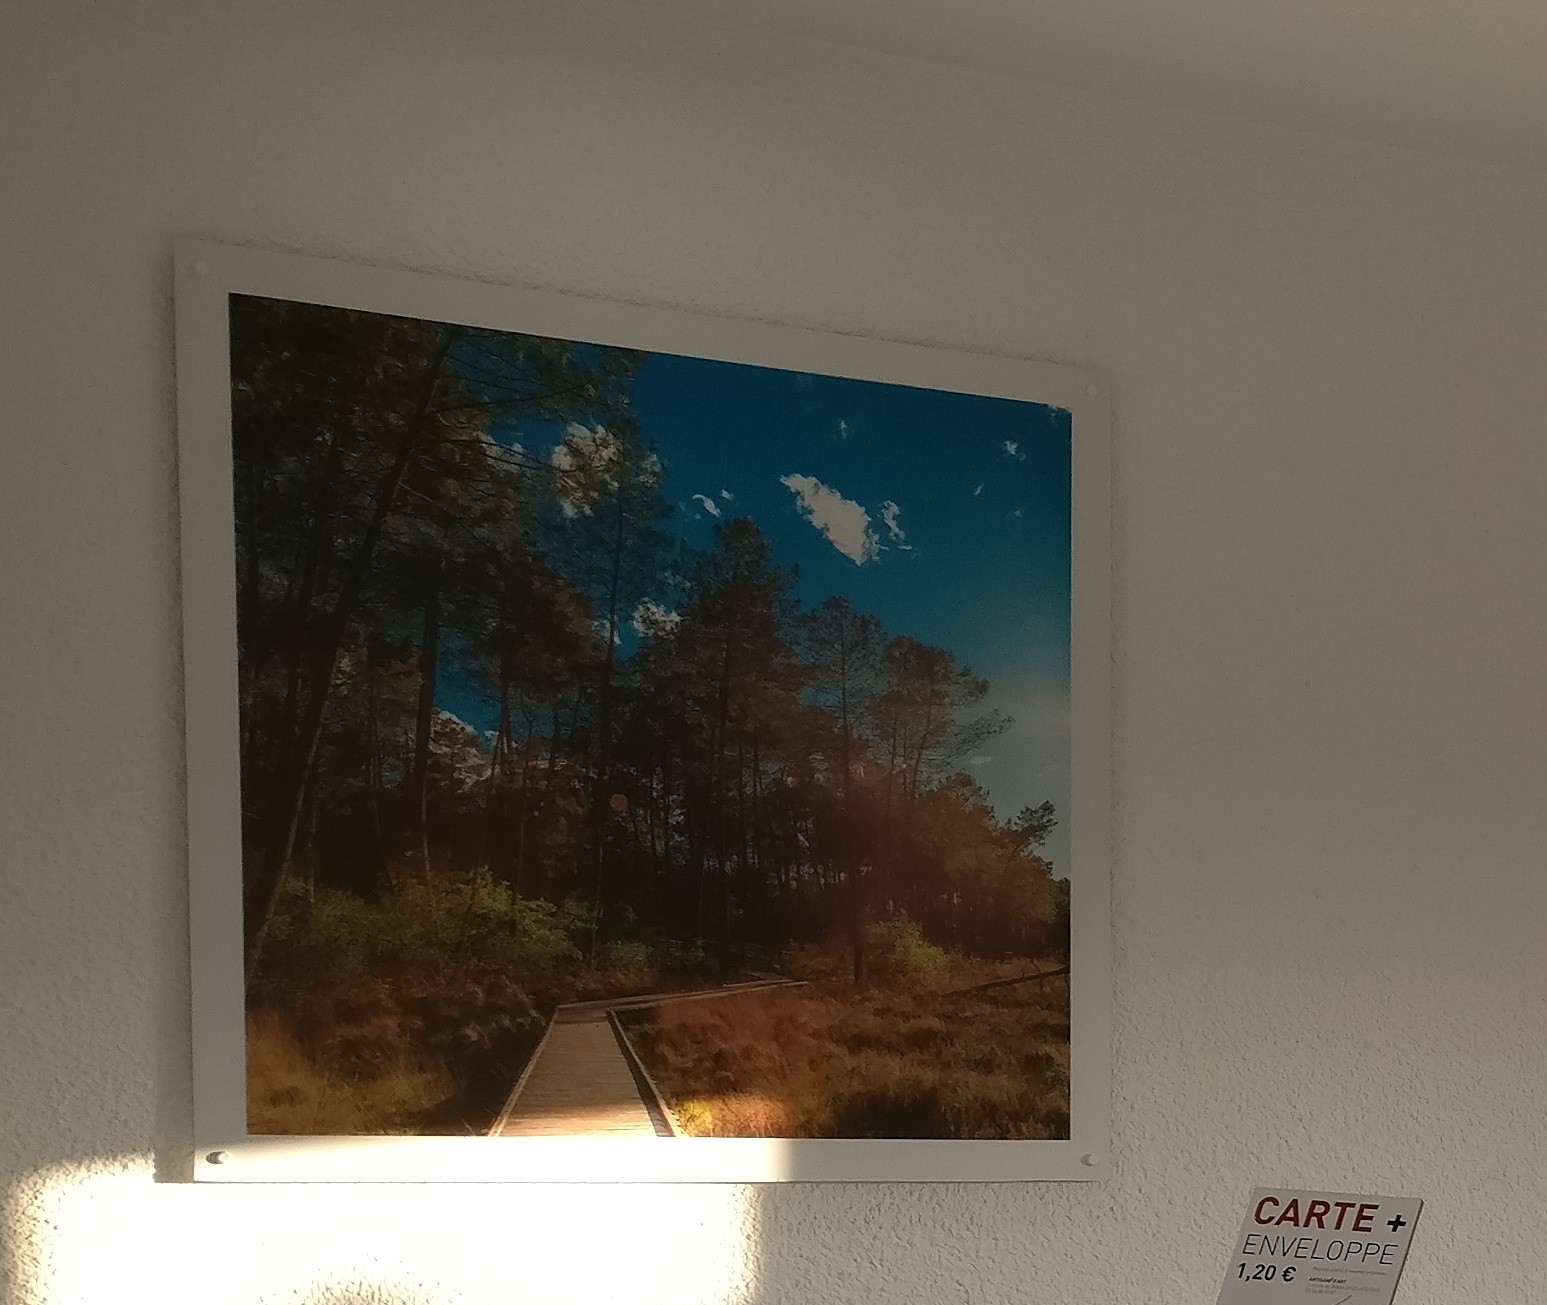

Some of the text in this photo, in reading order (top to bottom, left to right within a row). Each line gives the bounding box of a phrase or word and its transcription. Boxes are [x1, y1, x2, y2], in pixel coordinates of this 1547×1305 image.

[1254, 1196, 1380, 1233] CARTE
[1242, 1233, 1399, 1265] ENVELOPPE
[1236, 1262, 1277, 1283] 1,20
[1281, 1265, 1297, 1283] €
